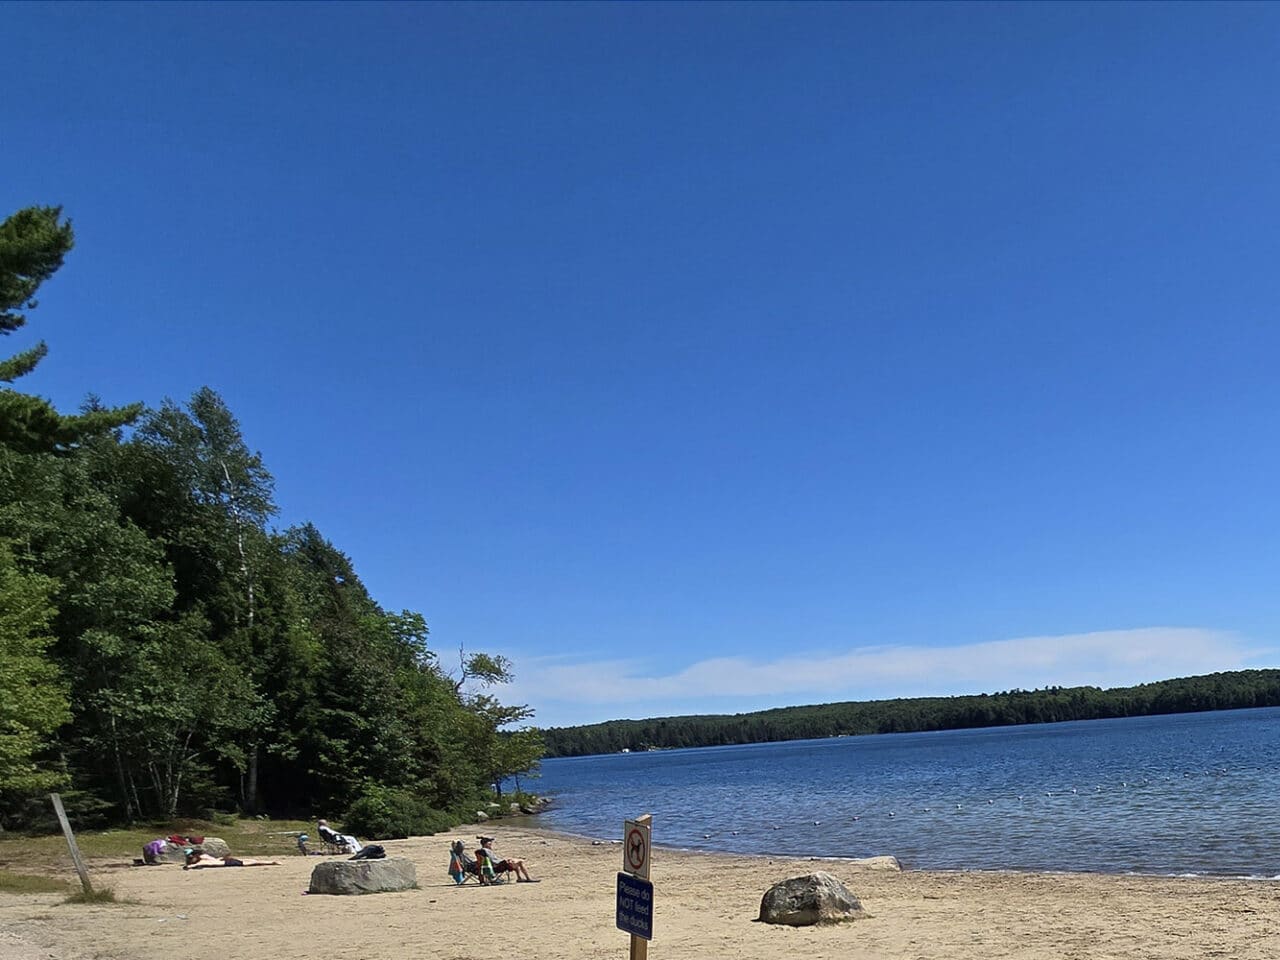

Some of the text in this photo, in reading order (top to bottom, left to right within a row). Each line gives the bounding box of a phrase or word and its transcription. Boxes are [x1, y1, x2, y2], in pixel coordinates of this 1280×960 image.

[619, 881, 640, 897] Please
[619, 895, 649, 915] NOT feed
